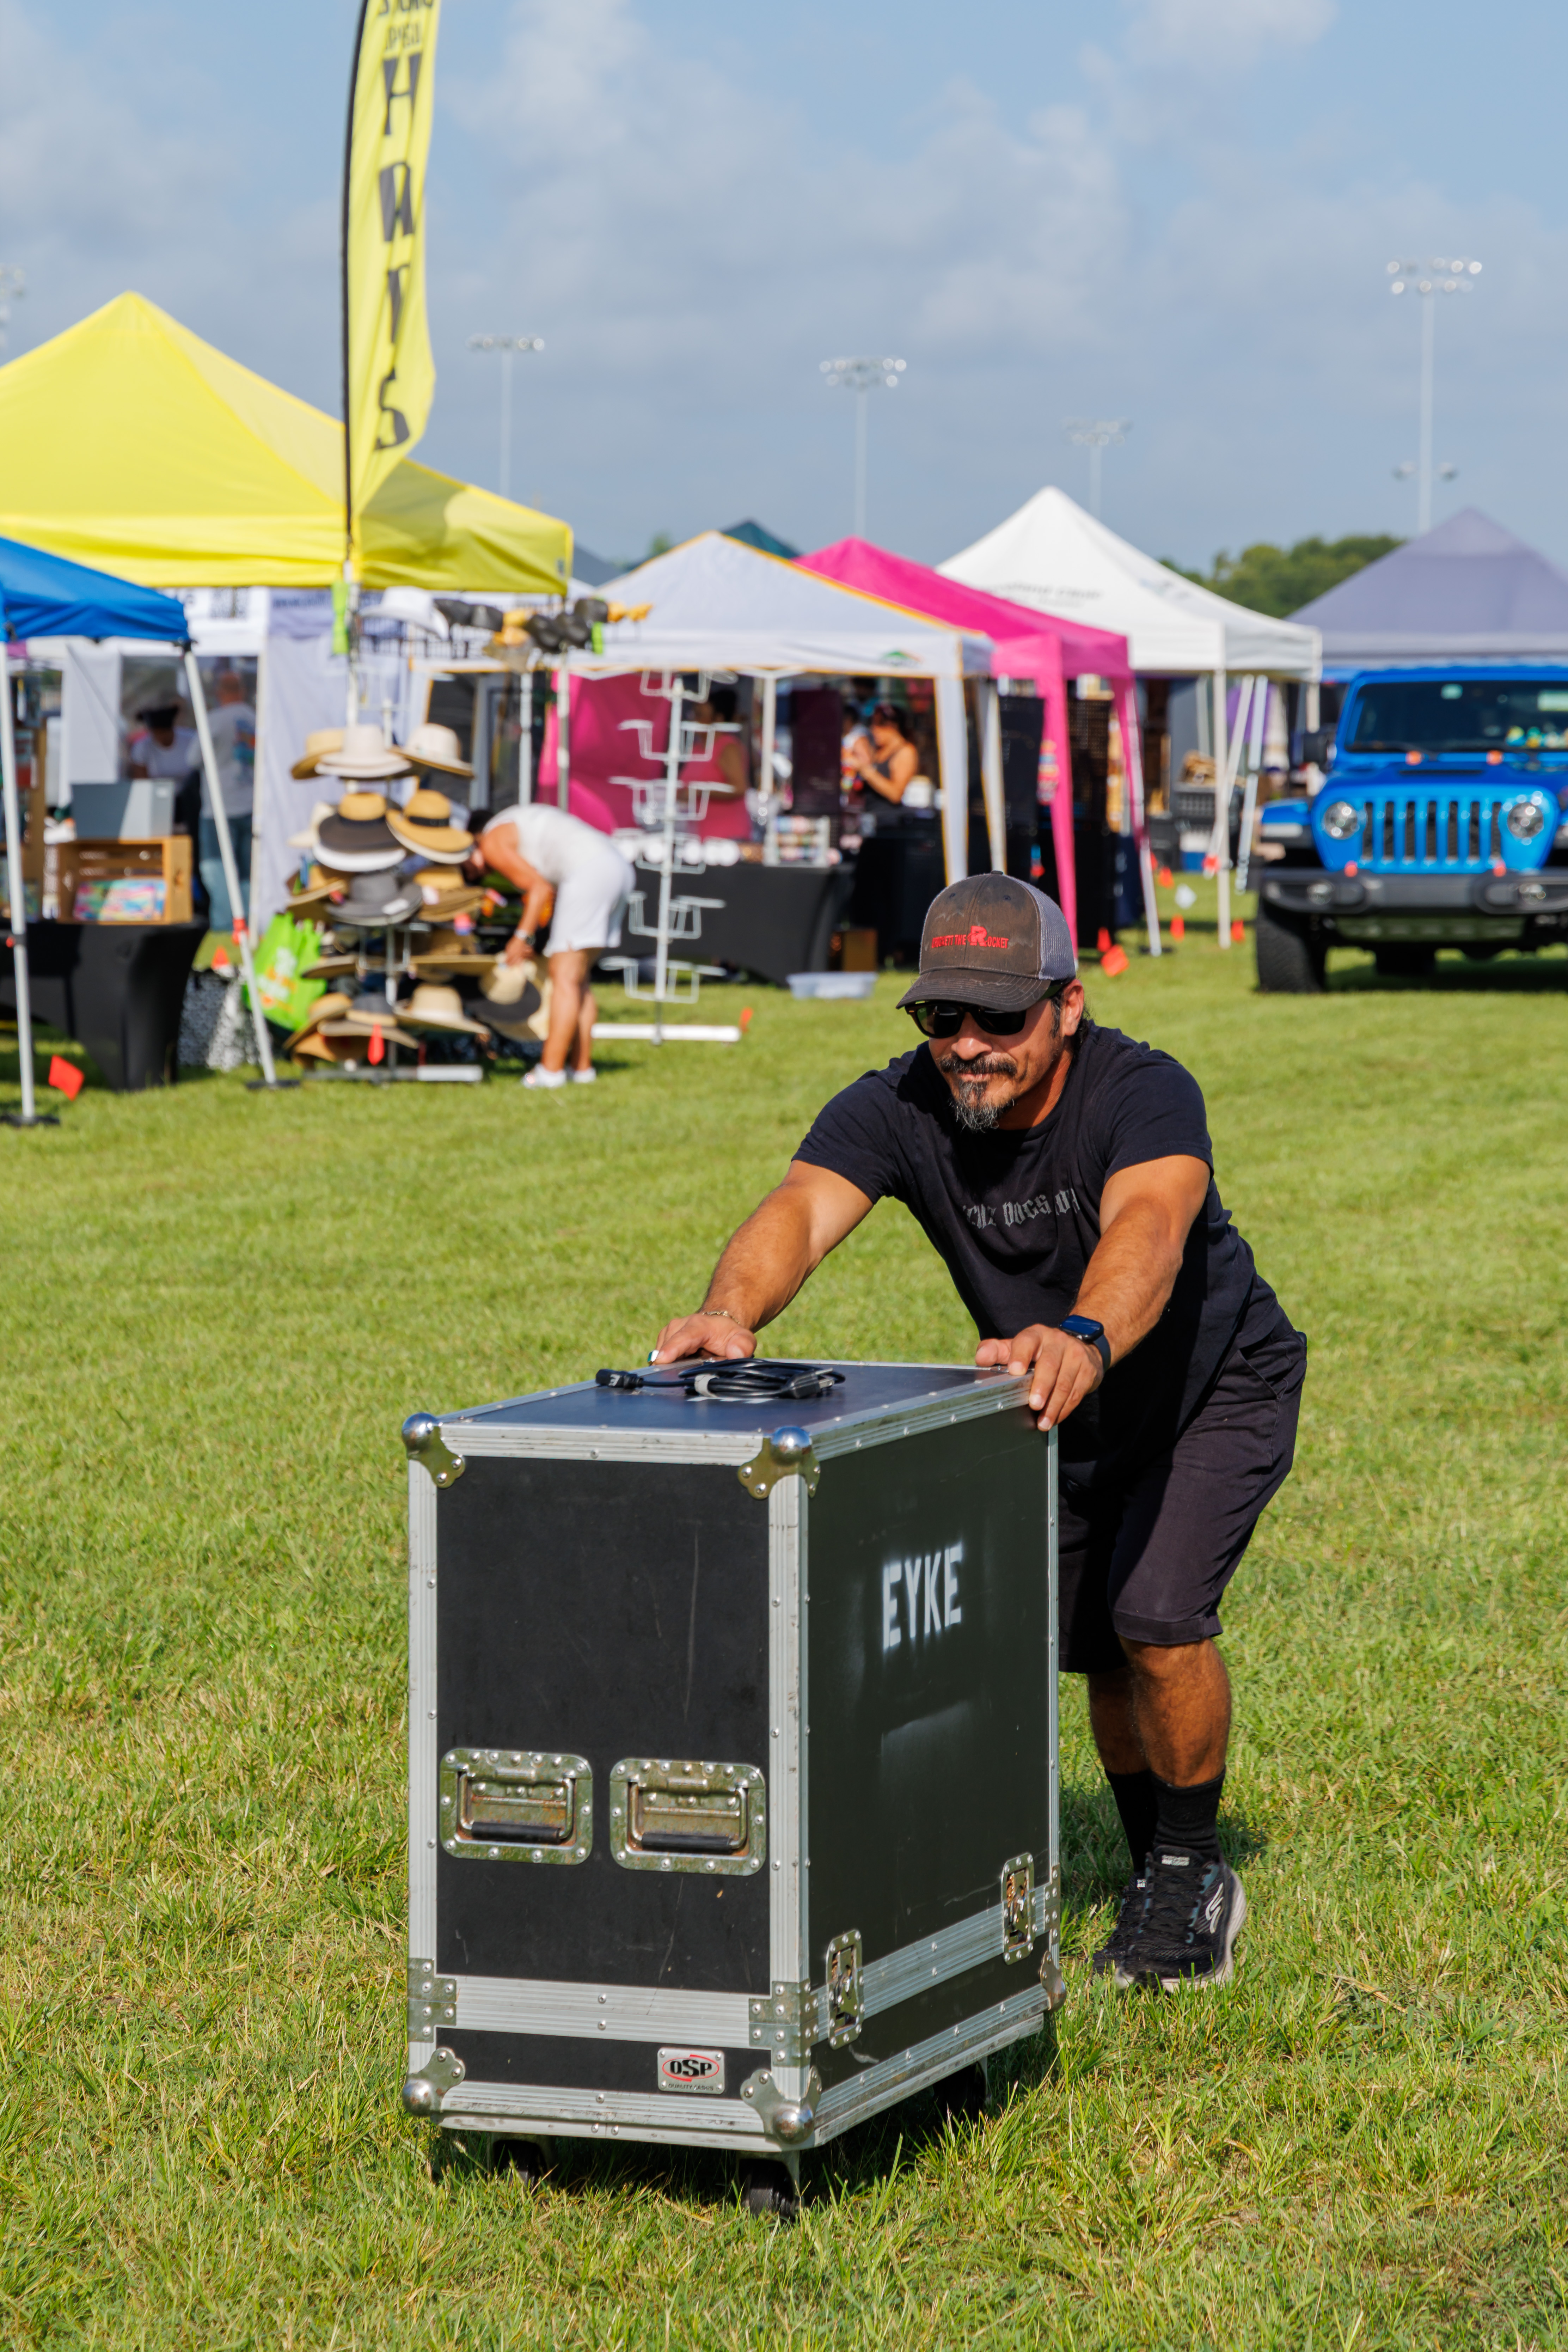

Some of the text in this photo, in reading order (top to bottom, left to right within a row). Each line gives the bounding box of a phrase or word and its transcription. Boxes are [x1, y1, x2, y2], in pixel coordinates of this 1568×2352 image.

[955, 934, 966, 945] THE
[967, 925, 1009, 948] ROCKET
[883, 1541, 963, 1651] EYKE
[670, 2059, 712, 2077] OSP
